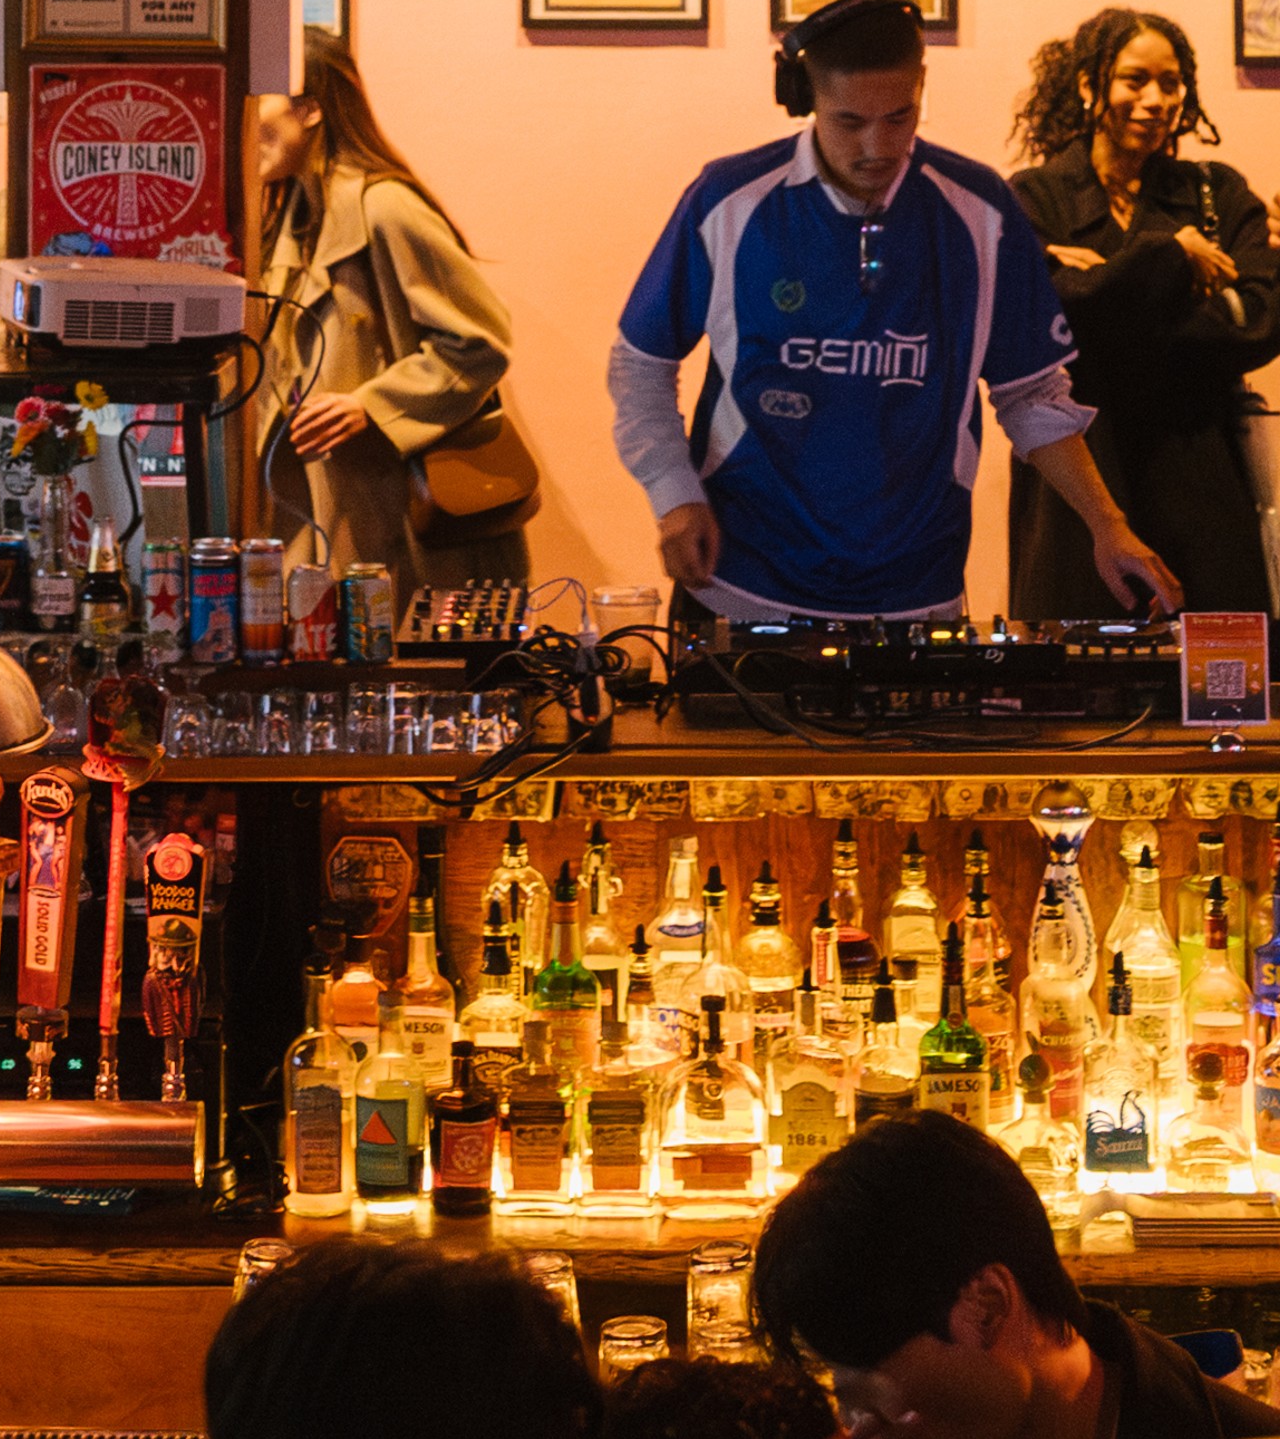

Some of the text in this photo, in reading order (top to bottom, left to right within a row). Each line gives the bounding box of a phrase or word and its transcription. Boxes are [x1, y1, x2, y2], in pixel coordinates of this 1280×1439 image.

[62, 144, 196, 182] CONEY ISLAND
[92, 221, 166, 241] BREWERY
[150, 883, 195, 898] VOODOO
[152, 897, 196, 911] RANGER
[34, 900, 50, 966] SOLID GOLD
